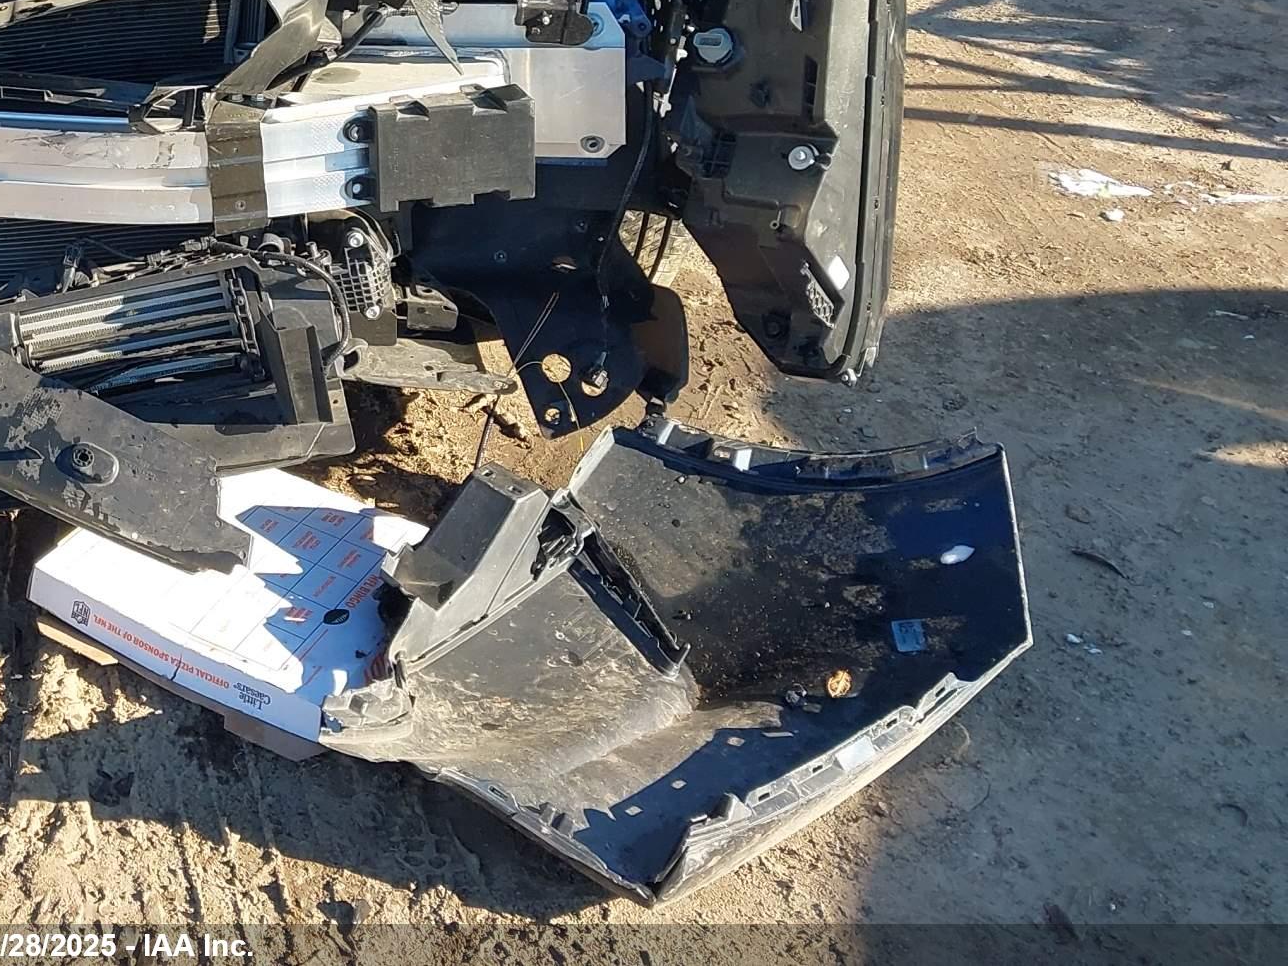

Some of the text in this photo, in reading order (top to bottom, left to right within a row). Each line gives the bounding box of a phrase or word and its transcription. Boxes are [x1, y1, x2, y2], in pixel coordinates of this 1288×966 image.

[94, 615, 230, 689] OFFICIAL PIZZA SPONSOR OF THE NFL
[239, 692, 263, 710] Little
